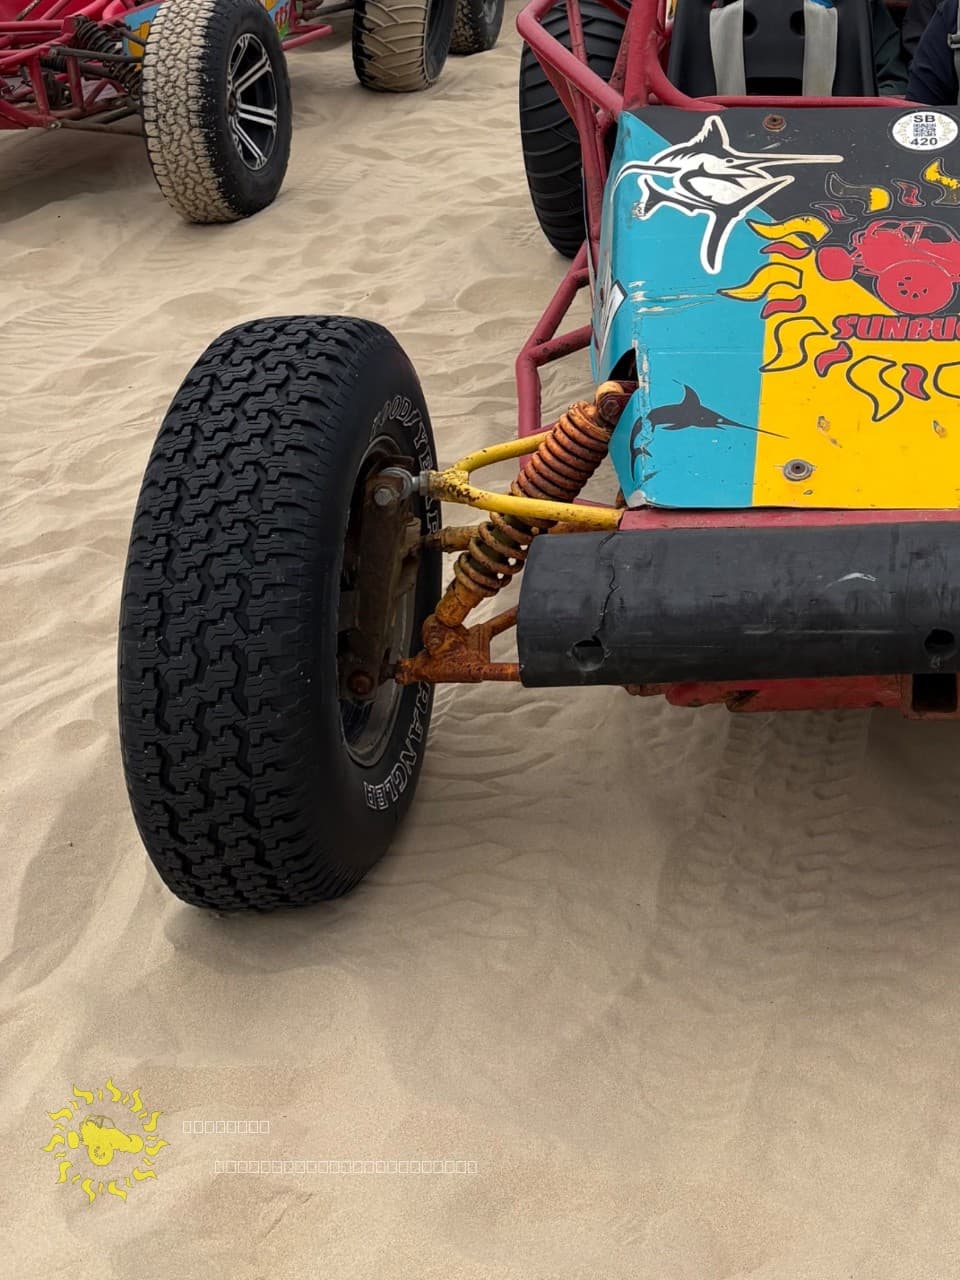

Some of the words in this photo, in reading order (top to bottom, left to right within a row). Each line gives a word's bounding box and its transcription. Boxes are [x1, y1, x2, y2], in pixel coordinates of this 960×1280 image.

[913, 114, 936, 123] SB
[910, 137, 938, 146] 420
[363, 678, 431, 810] RANGLER
